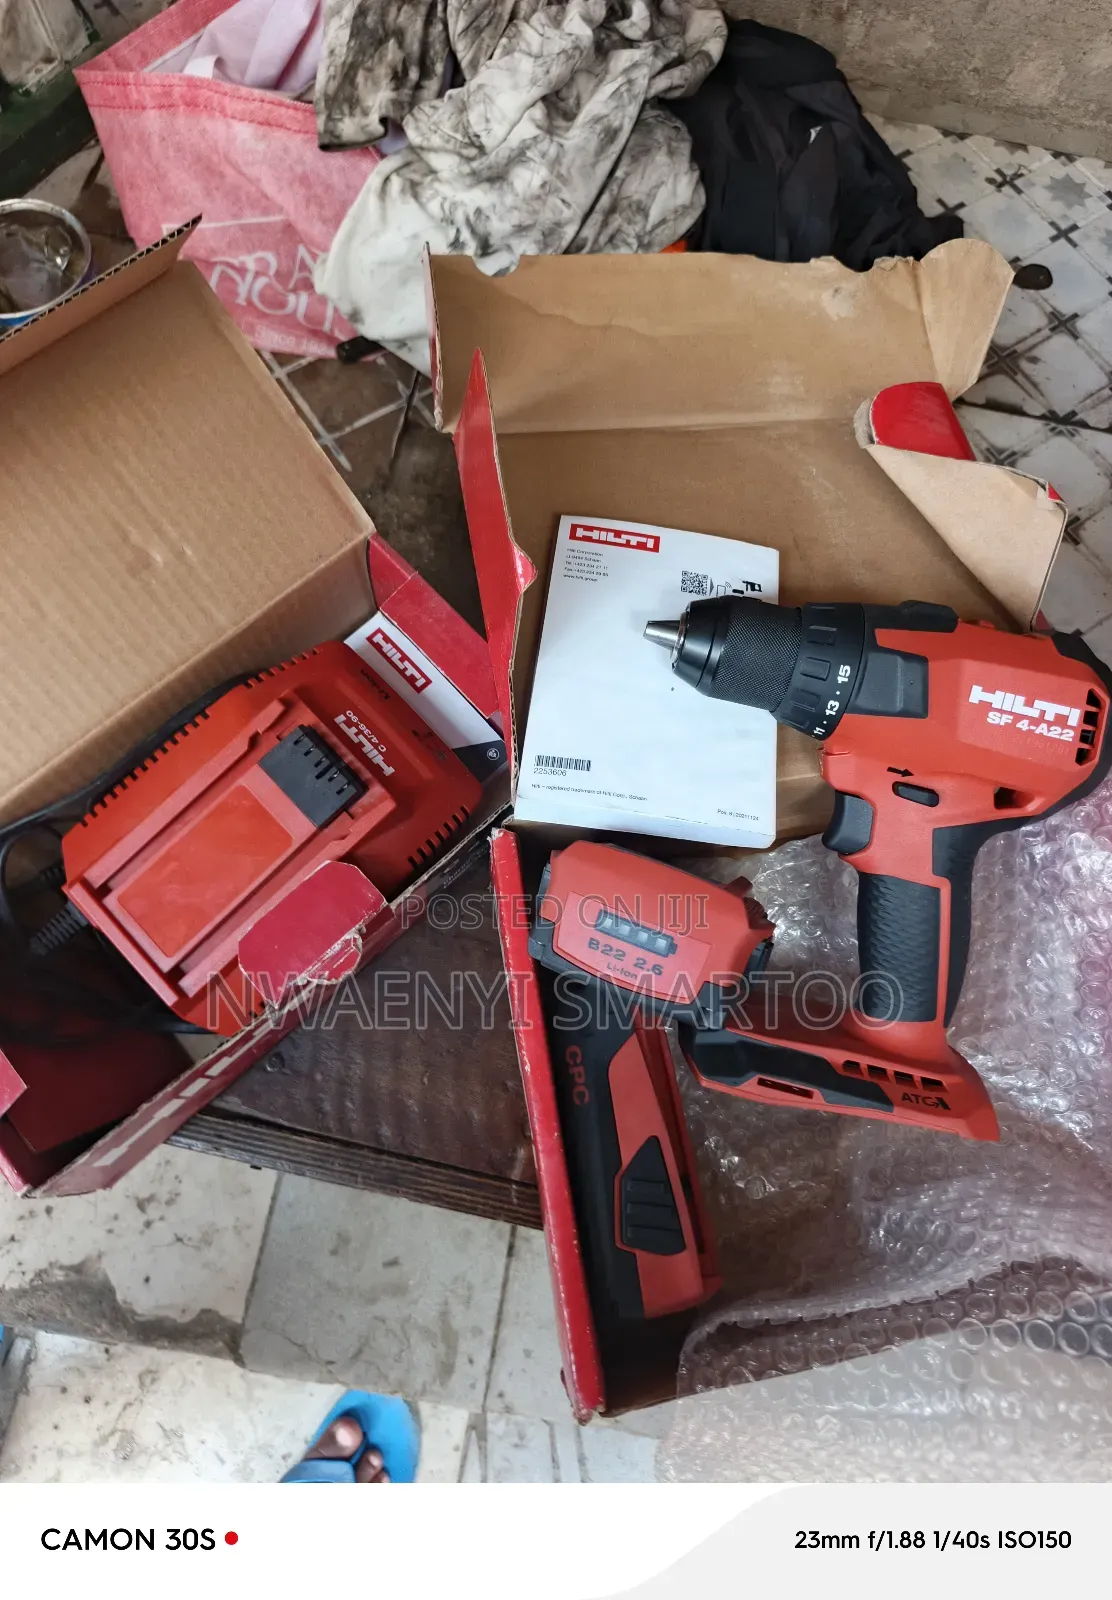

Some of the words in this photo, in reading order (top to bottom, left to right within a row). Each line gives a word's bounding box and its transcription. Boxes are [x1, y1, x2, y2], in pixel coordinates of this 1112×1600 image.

[576, 528, 654, 548] HILTI
[372, 632, 426, 688] HILTI
[825, 700, 840, 715] 13
[837, 665, 851, 683] 15
[969, 685, 1080, 727] HILTI
[334, 714, 396, 776] HILTI
[987, 711, 1013, 726] SF
[1016, 719, 1074, 742] 4-A22
[533, 767, 567, 776] 2253606
[588, 937, 626, 961] B22
[633, 957, 664, 976] 2.6
[606, 961, 638, 980] Li-Ion
[566, 1044, 589, 1106] CPC
